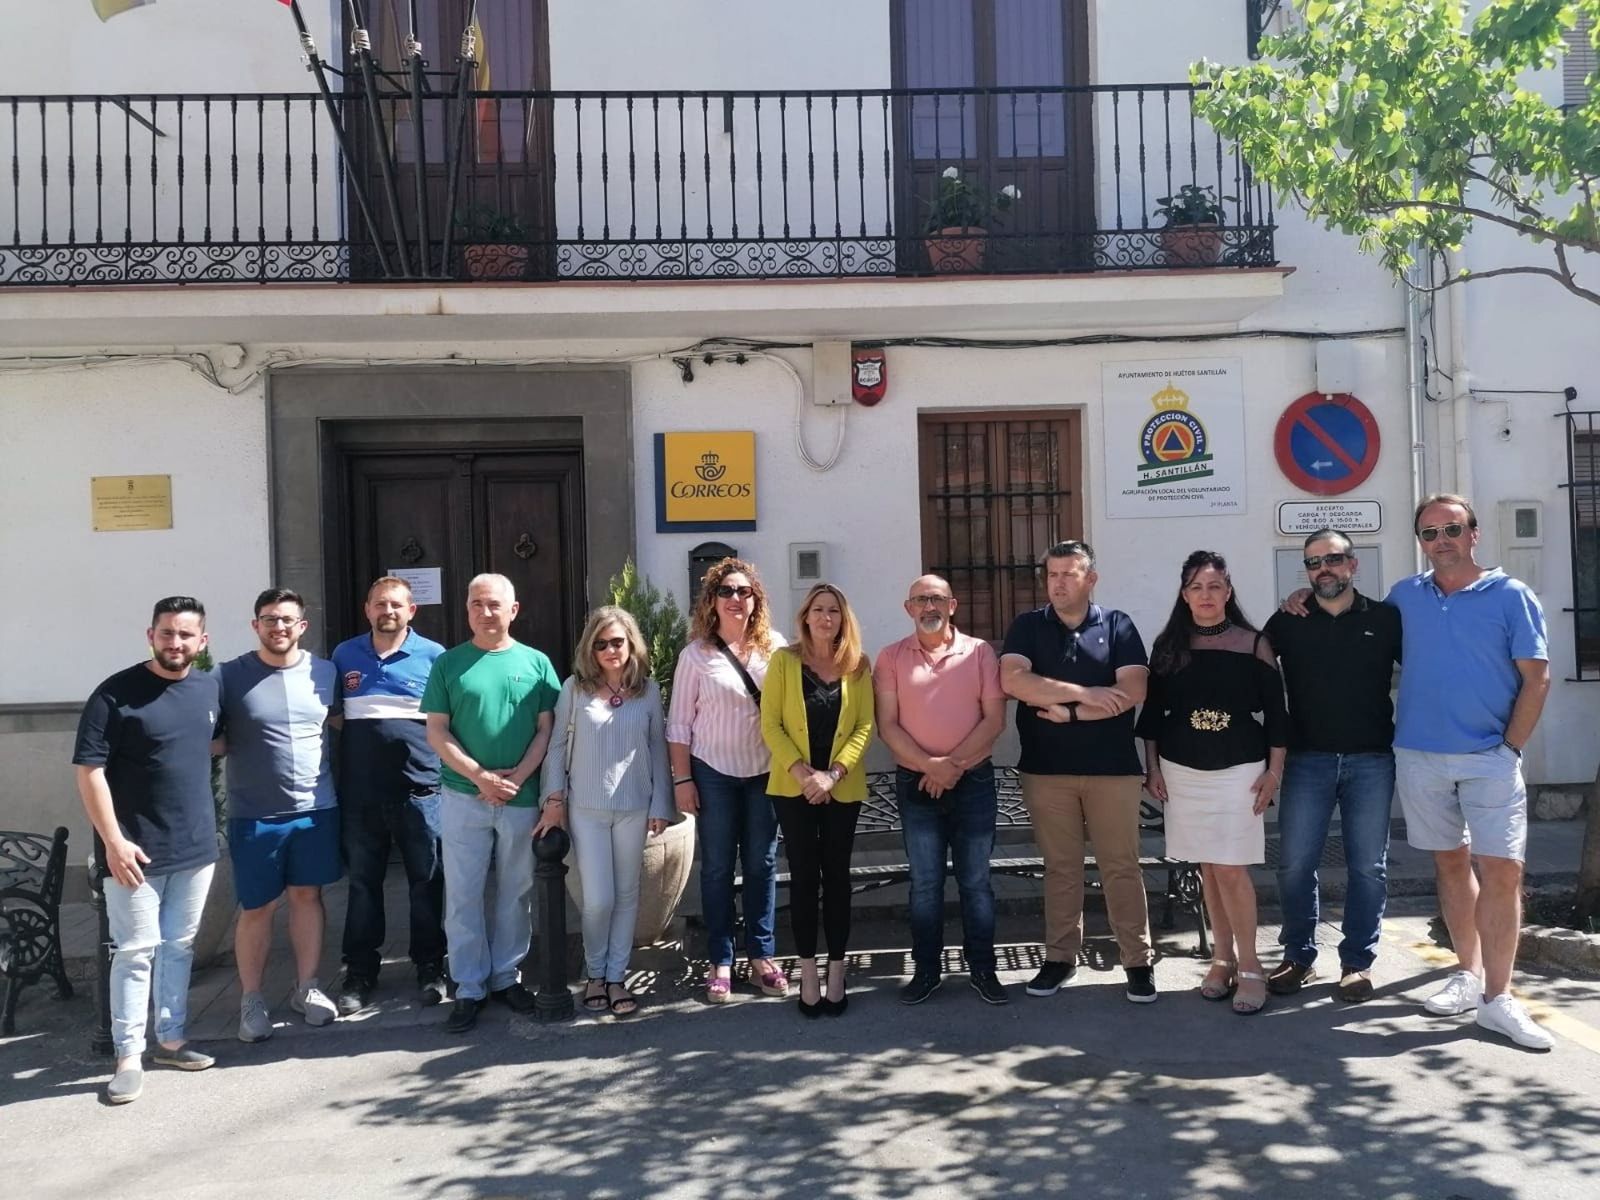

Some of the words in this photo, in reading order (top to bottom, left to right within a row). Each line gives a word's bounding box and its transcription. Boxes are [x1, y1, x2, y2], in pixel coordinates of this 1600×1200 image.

[1118, 371, 1164, 379] AYUNTAMIENTO
[1173, 369, 1196, 377] HUÉTOR
[1197, 368, 1227, 376] SANTILLÁN
[1189, 421, 1204, 445] CIVIL
[1143, 472, 1153, 480] H.
[1155, 463, 1207, 478] SANTILLÁN
[1122, 488, 1158, 496] AGRUPACIÓN
